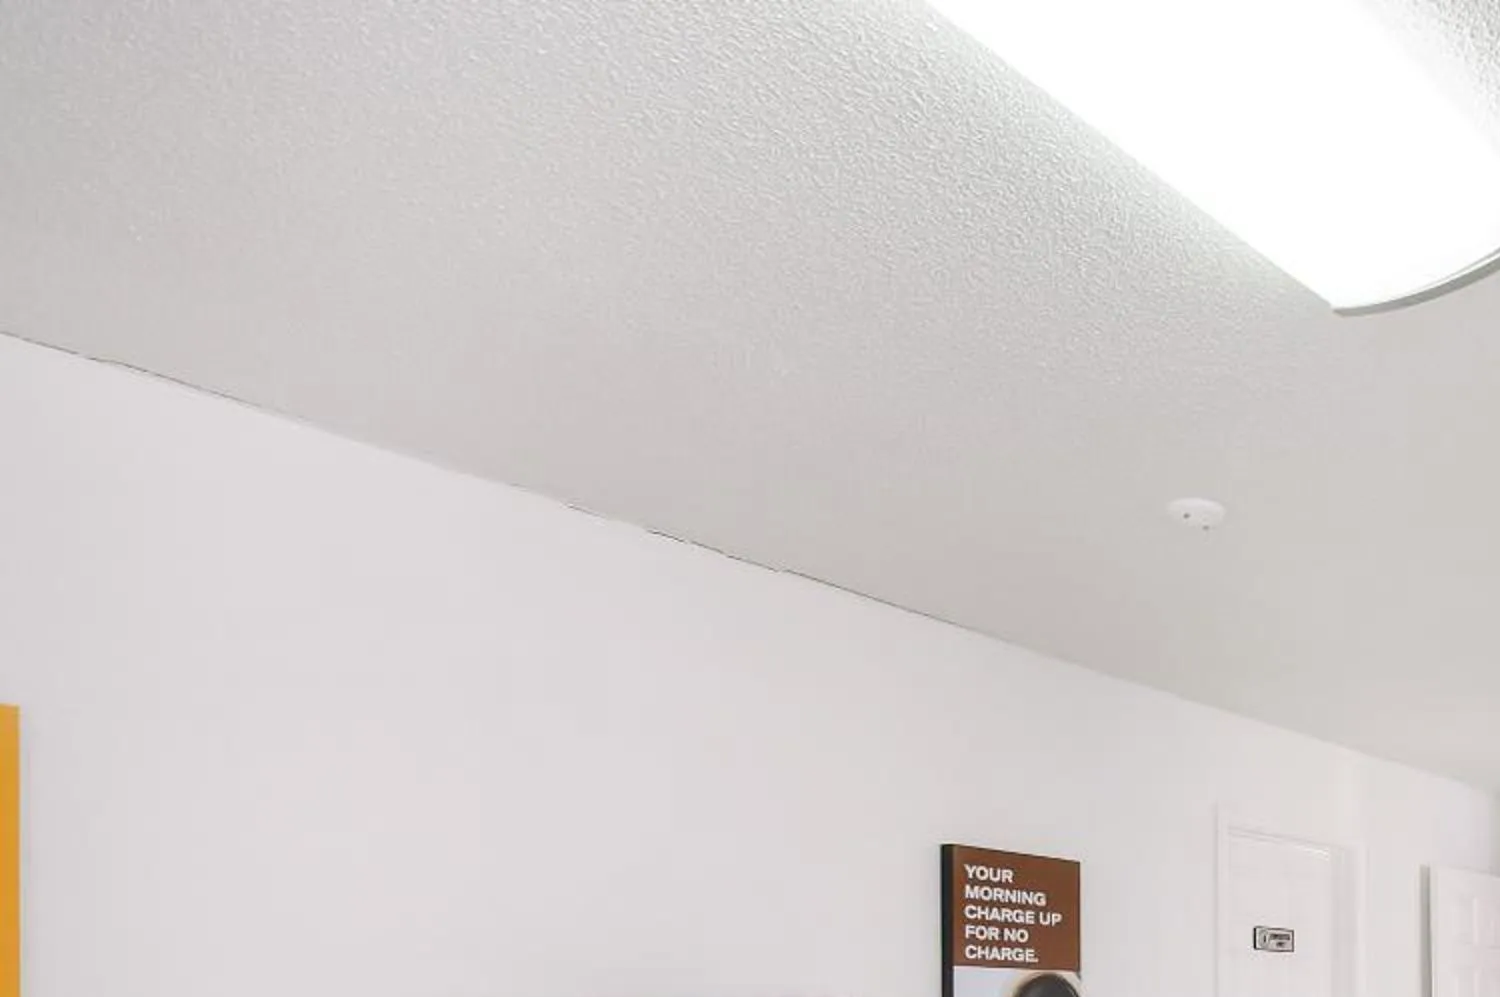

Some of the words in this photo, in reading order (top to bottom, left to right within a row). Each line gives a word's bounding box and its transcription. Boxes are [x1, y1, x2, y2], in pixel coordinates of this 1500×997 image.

[964, 864, 1014, 884] YOUR
[964, 885, 1047, 907] MORNING
[964, 905, 1036, 925] CHARGE
[1039, 913, 1063, 927] UP
[964, 925, 1001, 942] FOR
[1003, 928, 1030, 944] NO
[964, 945, 1040, 964] CHARGE.
